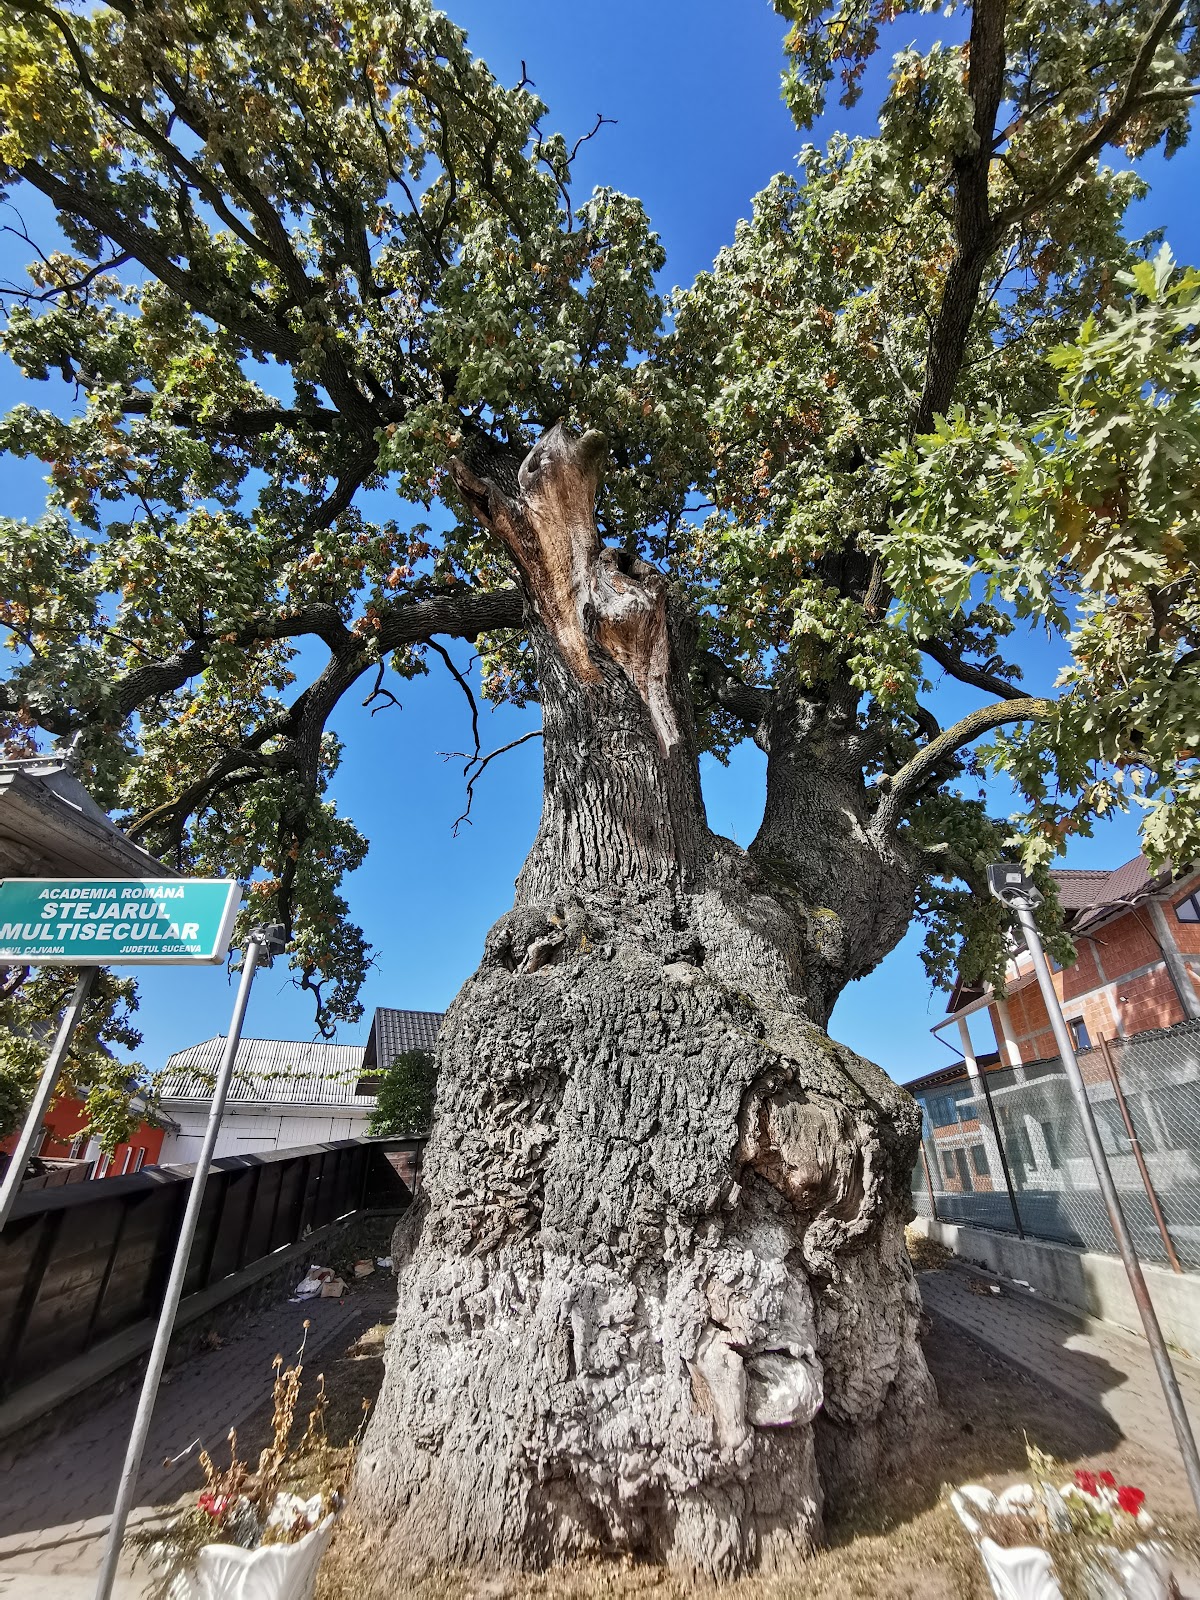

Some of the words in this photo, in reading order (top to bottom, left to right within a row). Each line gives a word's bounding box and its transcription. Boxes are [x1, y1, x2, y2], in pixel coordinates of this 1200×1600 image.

[39, 889, 116, 899] ACADEMIA
[121, 886, 185, 899] ROMÂNĂ
[41, 903, 170, 919] STEJARUL
[0, 923, 199, 940] MULTISECULAR
[24, 946, 65, 954] CAJVANA
[161, 944, 201, 953] SUCEAVA
